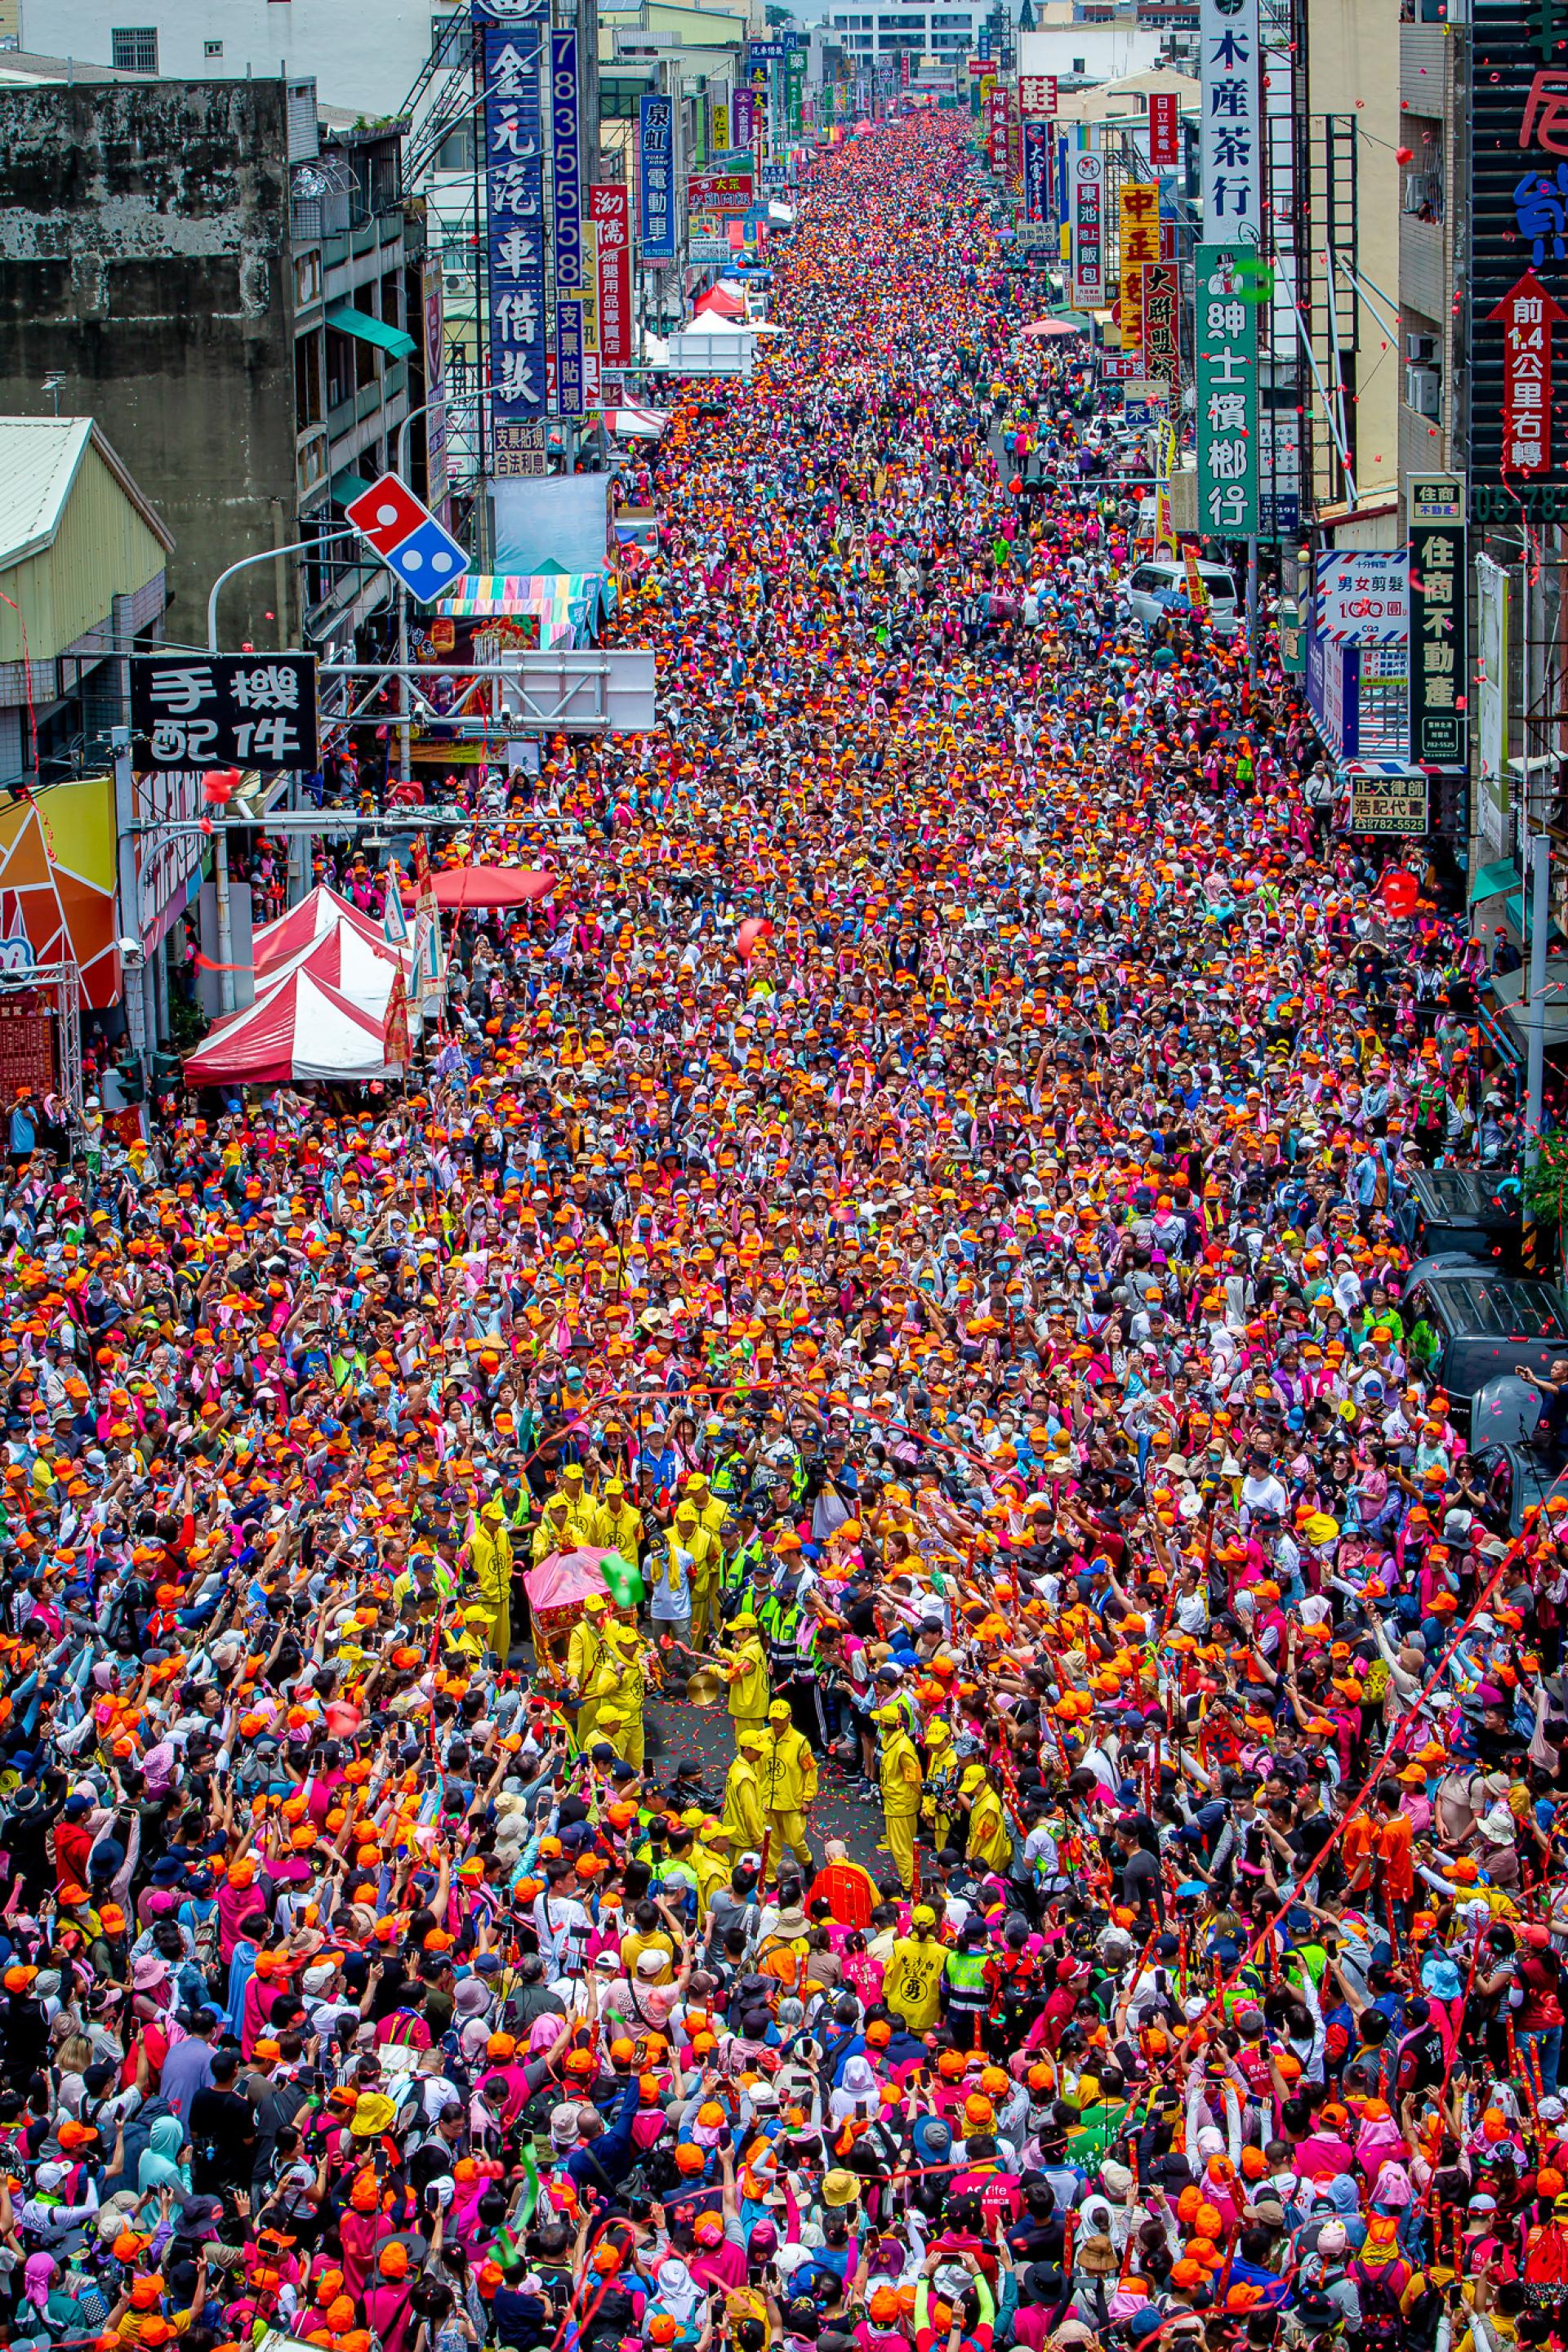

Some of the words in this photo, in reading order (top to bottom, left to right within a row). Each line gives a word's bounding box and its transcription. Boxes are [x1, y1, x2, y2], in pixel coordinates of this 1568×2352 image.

[1021, 78, 1055, 112] 鞋
[644, 104, 670, 151] 泉虹
[553, 34, 579, 283] 7835558
[647, 168, 667, 238] 電動車
[490, 43, 541, 403] 金元汽車借款
[561, 305, 580, 412] 支票貼現
[497, 428, 544, 450] 支票貼現
[496, 452, 544, 475] 合法利息
[1419, 487, 1454, 501] 住商
[1338, 576, 1404, 591] 男女剪髮
[1422, 536, 1454, 708] 住商不動產
[150, 666, 300, 711] 手機
[151, 719, 300, 762] 配件
[1355, 799, 1424, 816] 浩記代書
[1356, 780, 1424, 797] 正大律師
[1374, 819, 1424, 830] 782-5525
